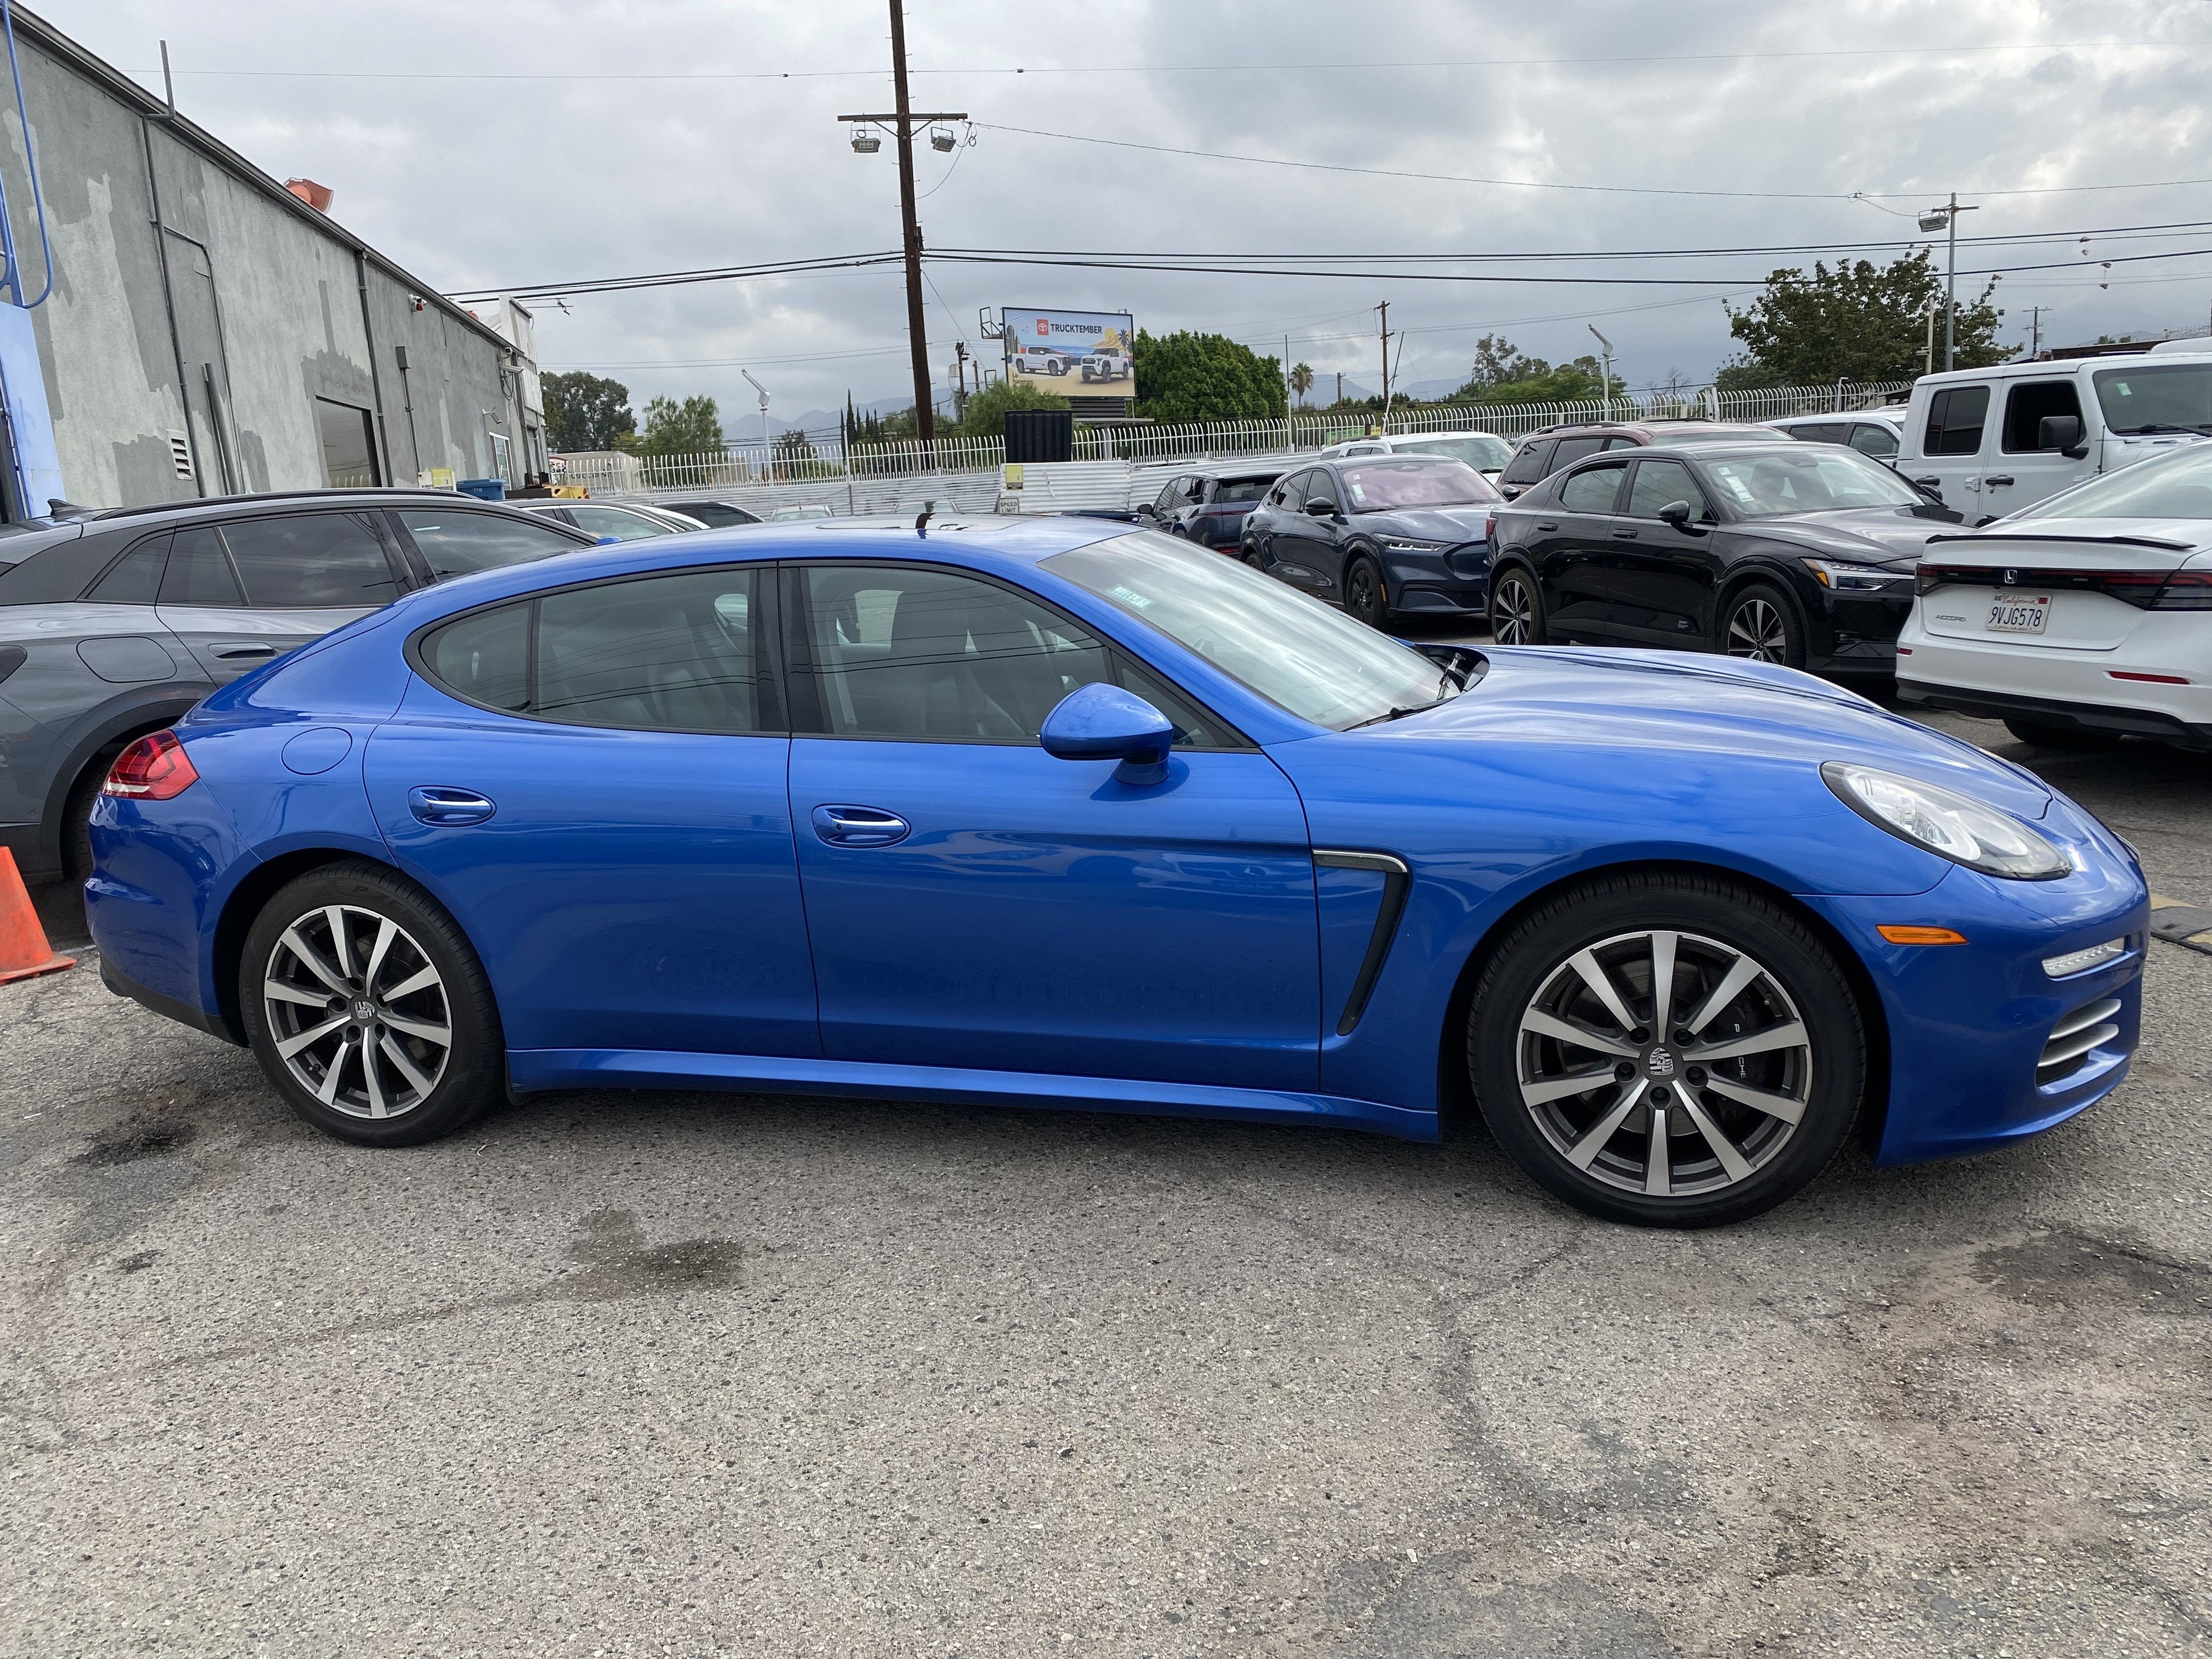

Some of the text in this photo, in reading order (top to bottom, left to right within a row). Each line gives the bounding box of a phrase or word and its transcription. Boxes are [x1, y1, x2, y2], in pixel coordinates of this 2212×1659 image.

[1051, 324, 1102, 334] TRUCKTEMBER
[2002, 594, 2039, 606] California
[1989, 606, 2042, 627] 9VJG578
